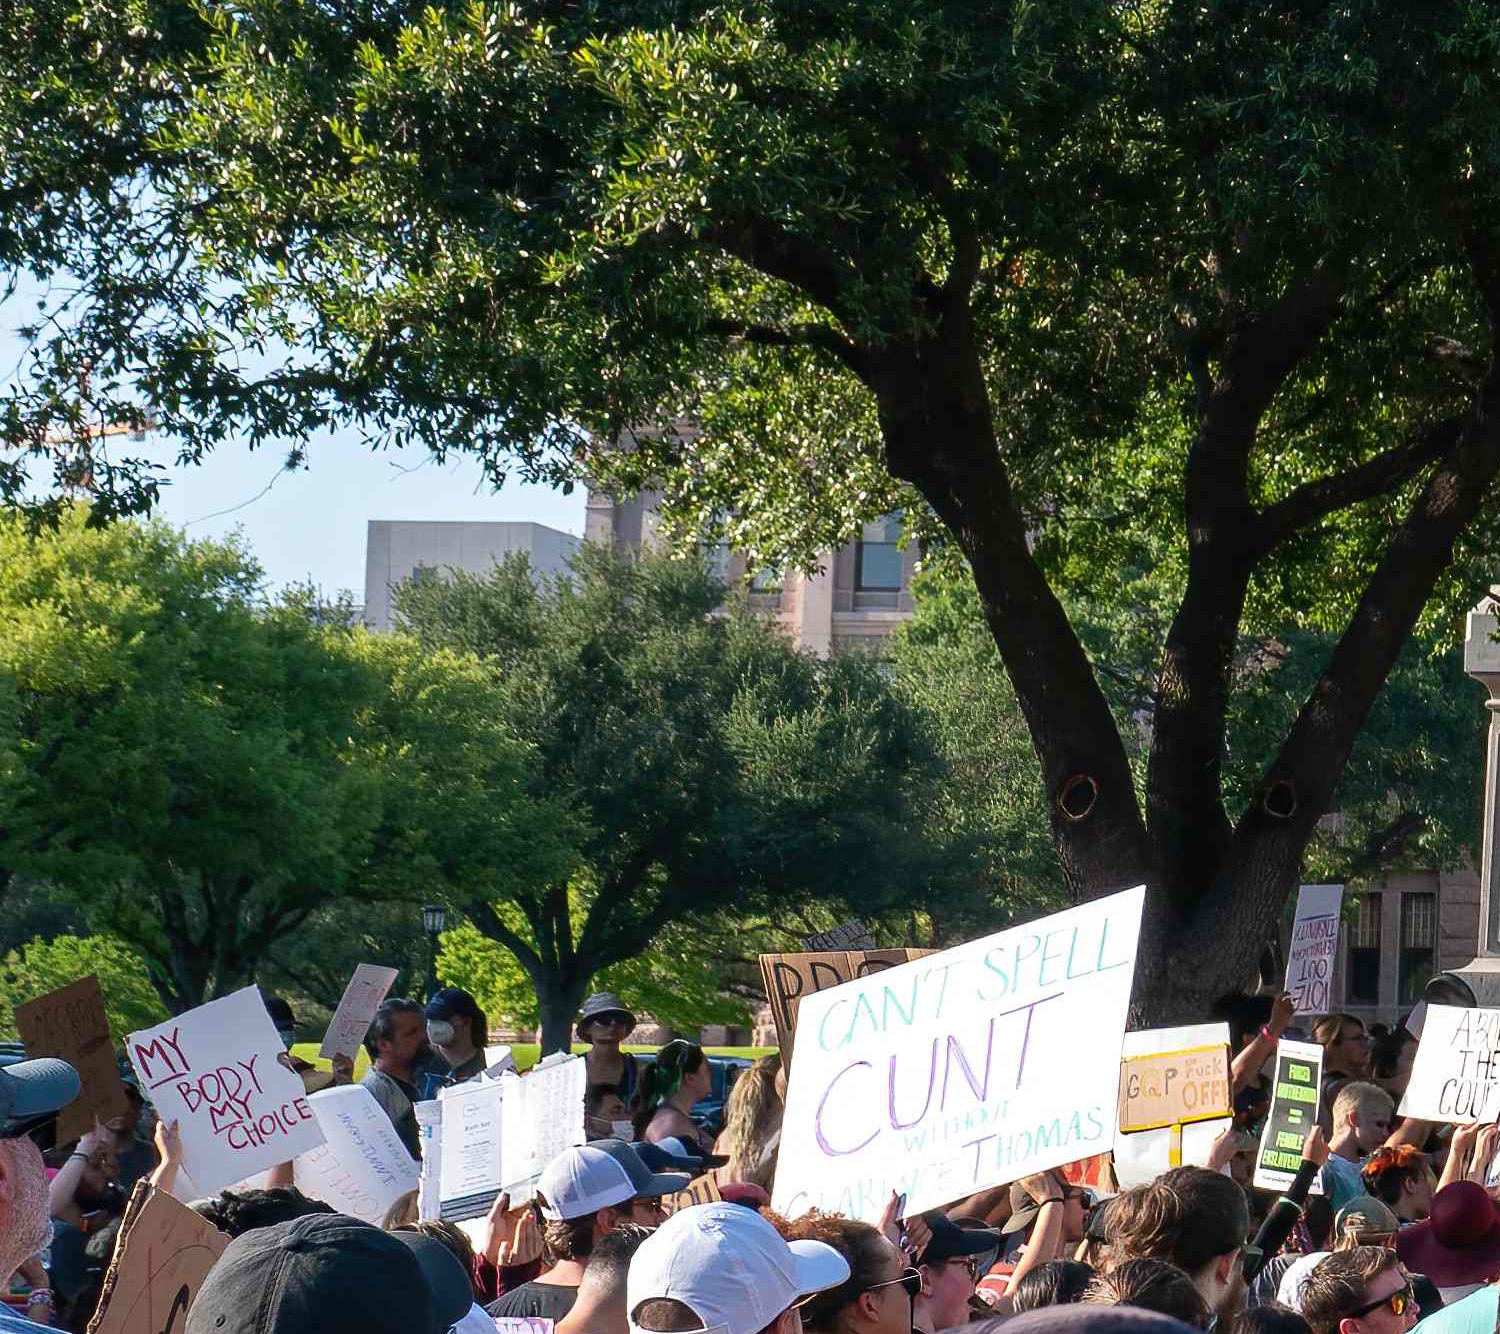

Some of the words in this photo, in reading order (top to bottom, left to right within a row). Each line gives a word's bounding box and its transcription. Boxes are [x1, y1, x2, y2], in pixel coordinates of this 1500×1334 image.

[978, 918, 1129, 1002] SPELL
[1298, 960, 1328, 983] OUT
[133, 1027, 191, 1079] MY
[815, 992, 1064, 1157] CUNT
[177, 1054, 265, 1113] BODY
[208, 1089, 254, 1129] MY
[227, 1098, 313, 1150] CHOICE
[962, 1106, 1102, 1184] THOMAS
